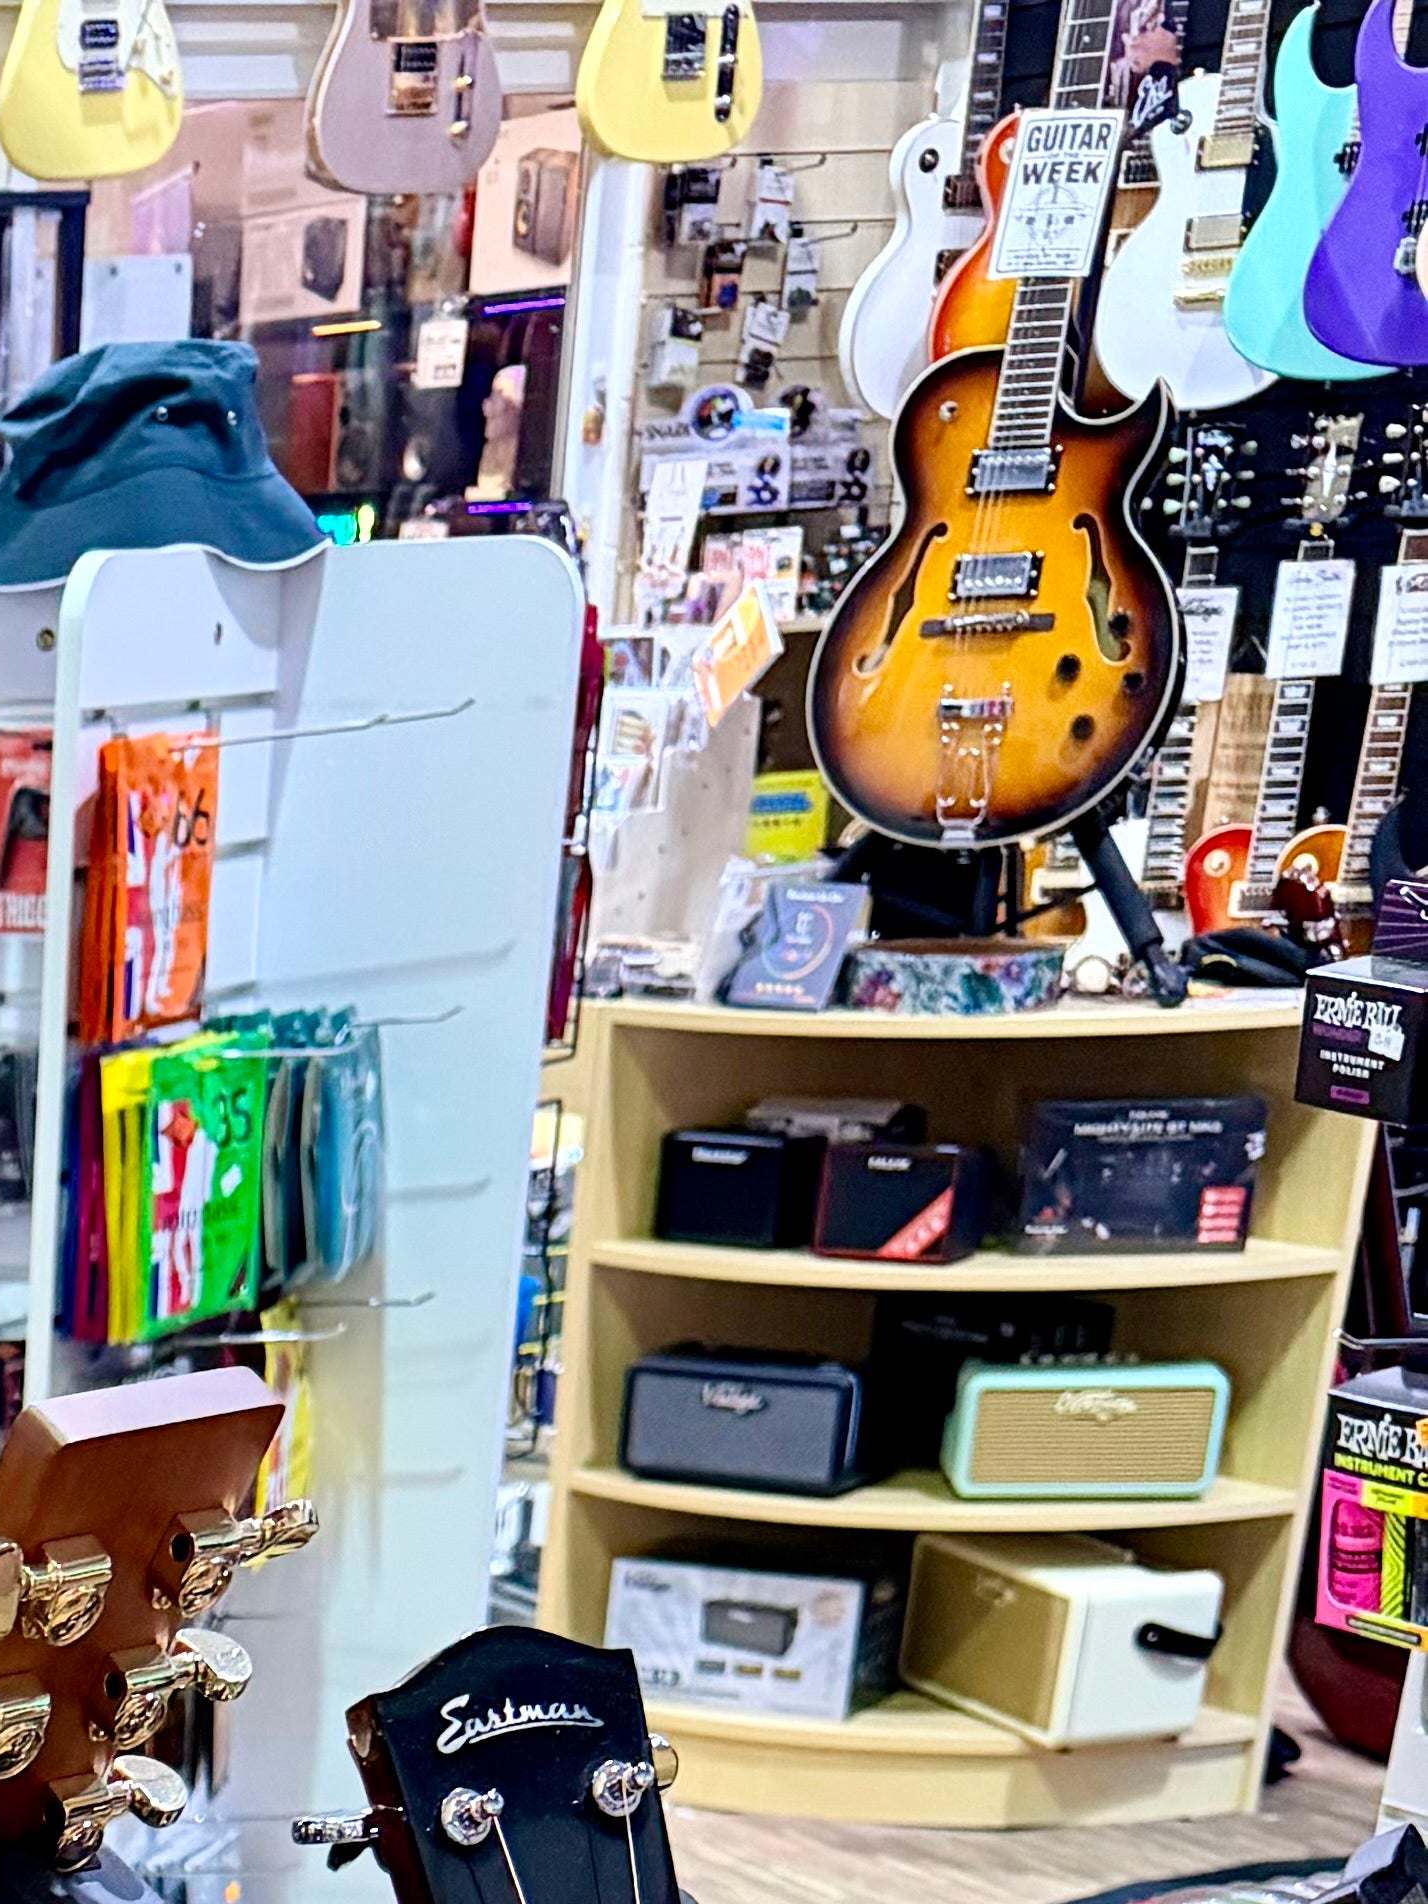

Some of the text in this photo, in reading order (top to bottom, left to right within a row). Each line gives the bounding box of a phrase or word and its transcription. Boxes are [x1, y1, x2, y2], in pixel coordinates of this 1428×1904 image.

[1026, 123, 1112, 153] GUITAR
[1022, 161, 1104, 186] WEEK
[1334, 1453, 1415, 1485] INSTRUMENT
[436, 1693, 605, 1754] Eastman
